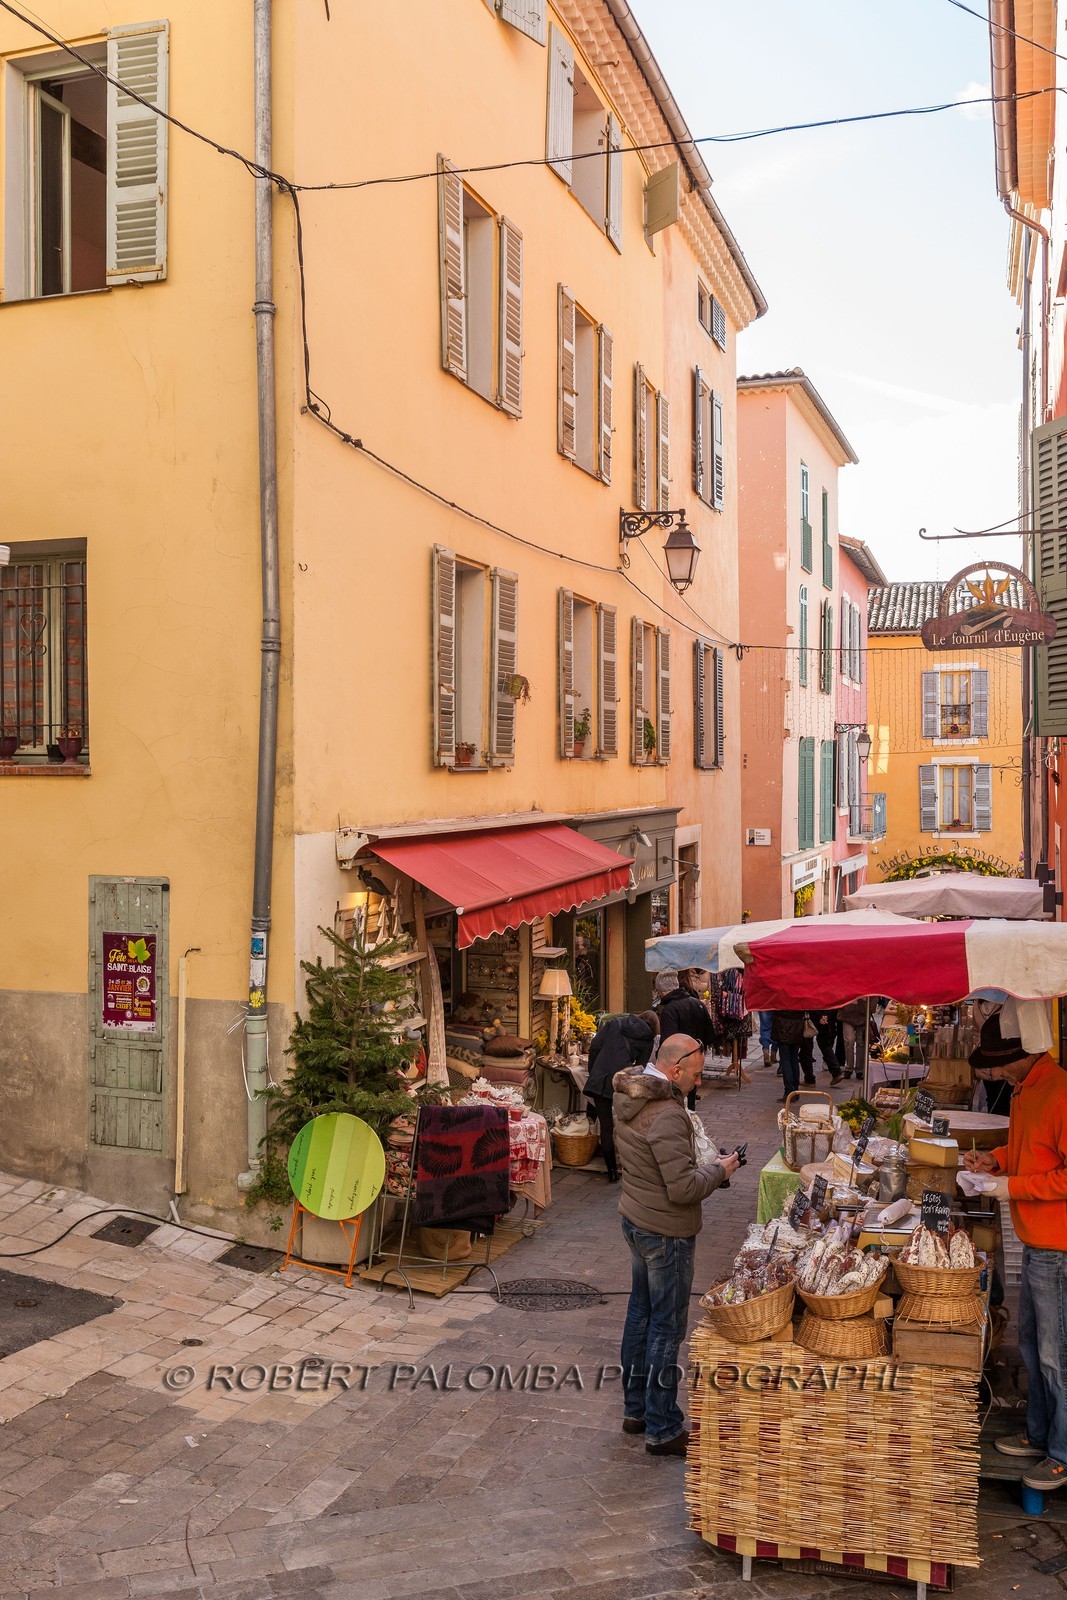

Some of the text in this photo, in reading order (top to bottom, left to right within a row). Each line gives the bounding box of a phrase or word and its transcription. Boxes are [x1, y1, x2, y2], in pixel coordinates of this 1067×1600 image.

[932, 629, 1045, 647] Le fournil d'Eugène
